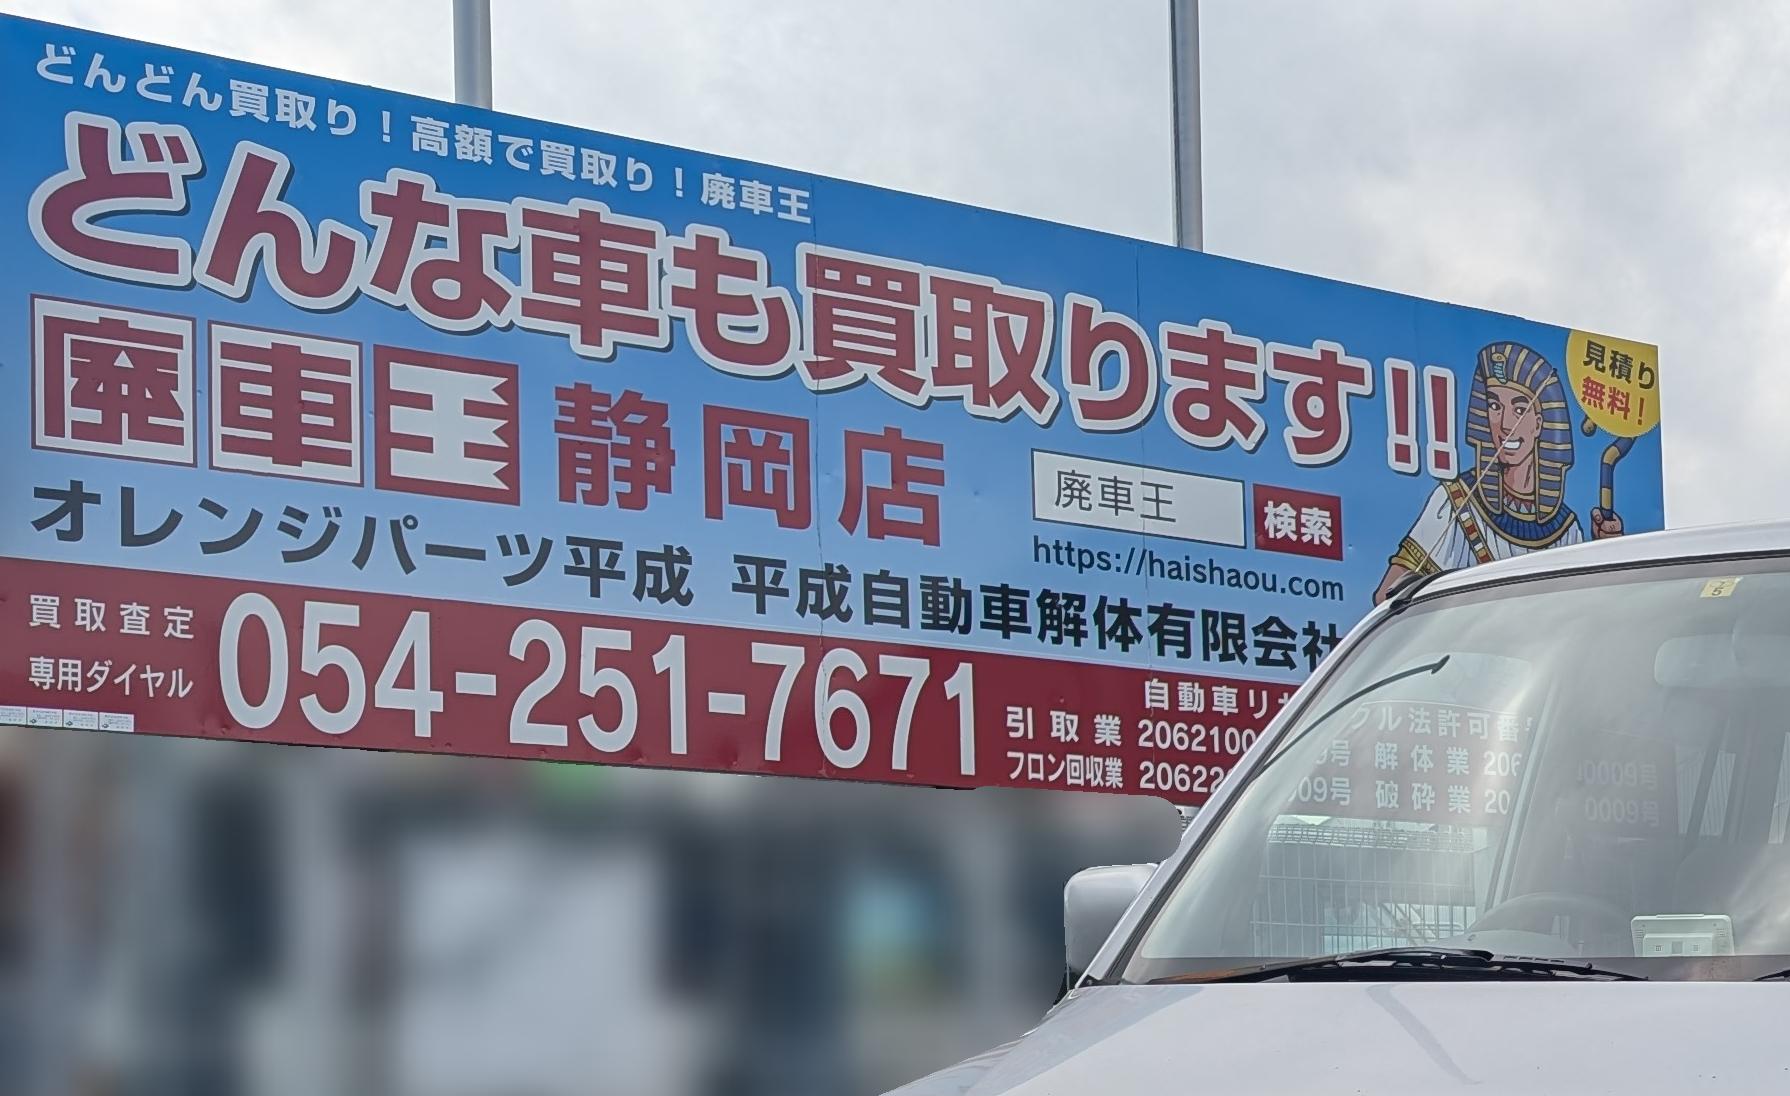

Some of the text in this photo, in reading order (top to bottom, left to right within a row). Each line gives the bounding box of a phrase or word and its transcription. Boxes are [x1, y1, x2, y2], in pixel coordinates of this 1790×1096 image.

[1583, 340, 1655, 390] 見積り
[553, 381, 945, 546] 静岡店
[1055, 469, 1176, 523] 廃車王
[1264, 500, 1332, 547] 検索
[31, 479, 695, 607] オレンジパーツ平成
[1033, 535, 1344, 601] https://haishaou.com
[29, 594, 194, 639] 買取査定
[28, 656, 193, 698] 専用ダイヤル
[219, 592, 977, 777] 054-251-7671
[1006, 706, 1121, 747] 引取業
[1374, 741, 1470, 775] 解体業
[1006, 751, 1124, 789] フロン回収業
[1375, 780, 1471, 814] 破砕業
